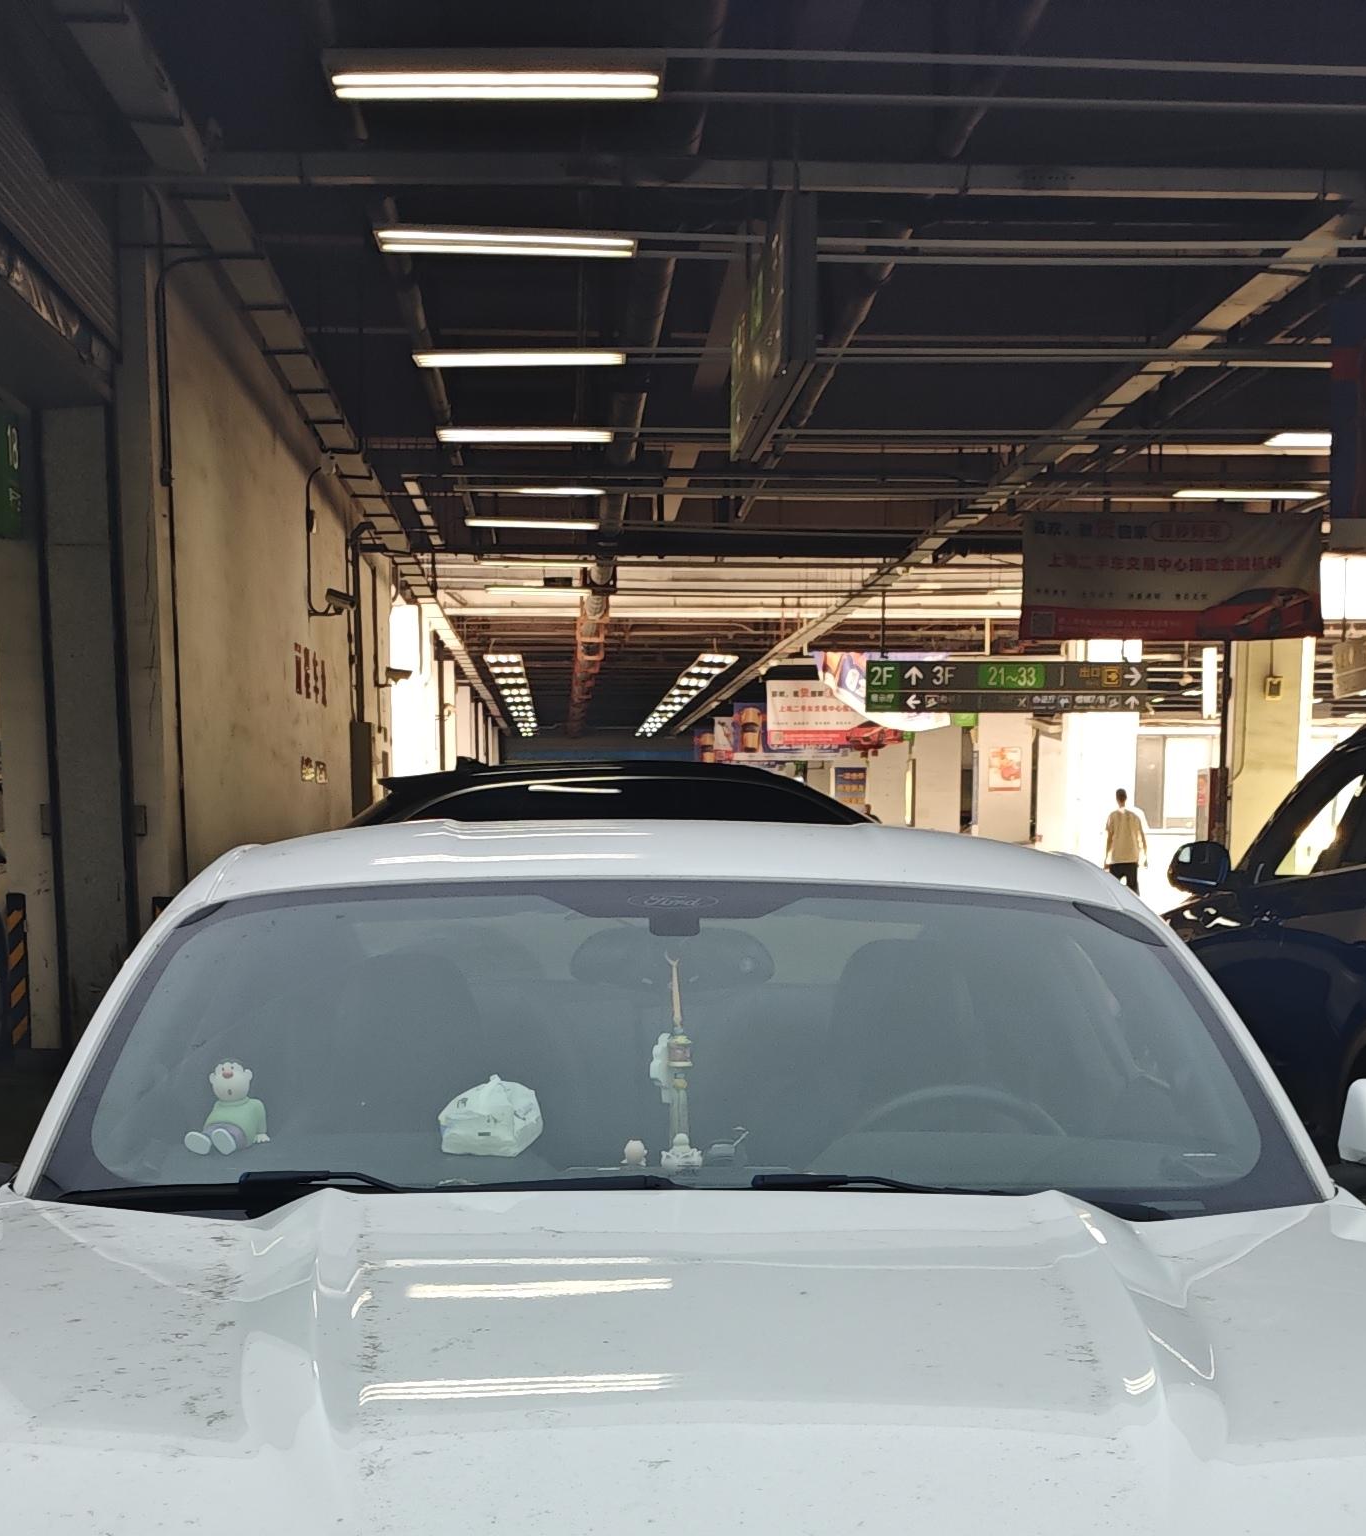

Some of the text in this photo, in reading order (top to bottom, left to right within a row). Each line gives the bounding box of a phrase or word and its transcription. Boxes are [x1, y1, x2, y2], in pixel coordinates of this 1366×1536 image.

[870, 665, 895, 686] 2F
[931, 665, 957, 686] 3F
[987, 666, 1037, 687] 21~33
[642, 894, 704, 907] Ford
